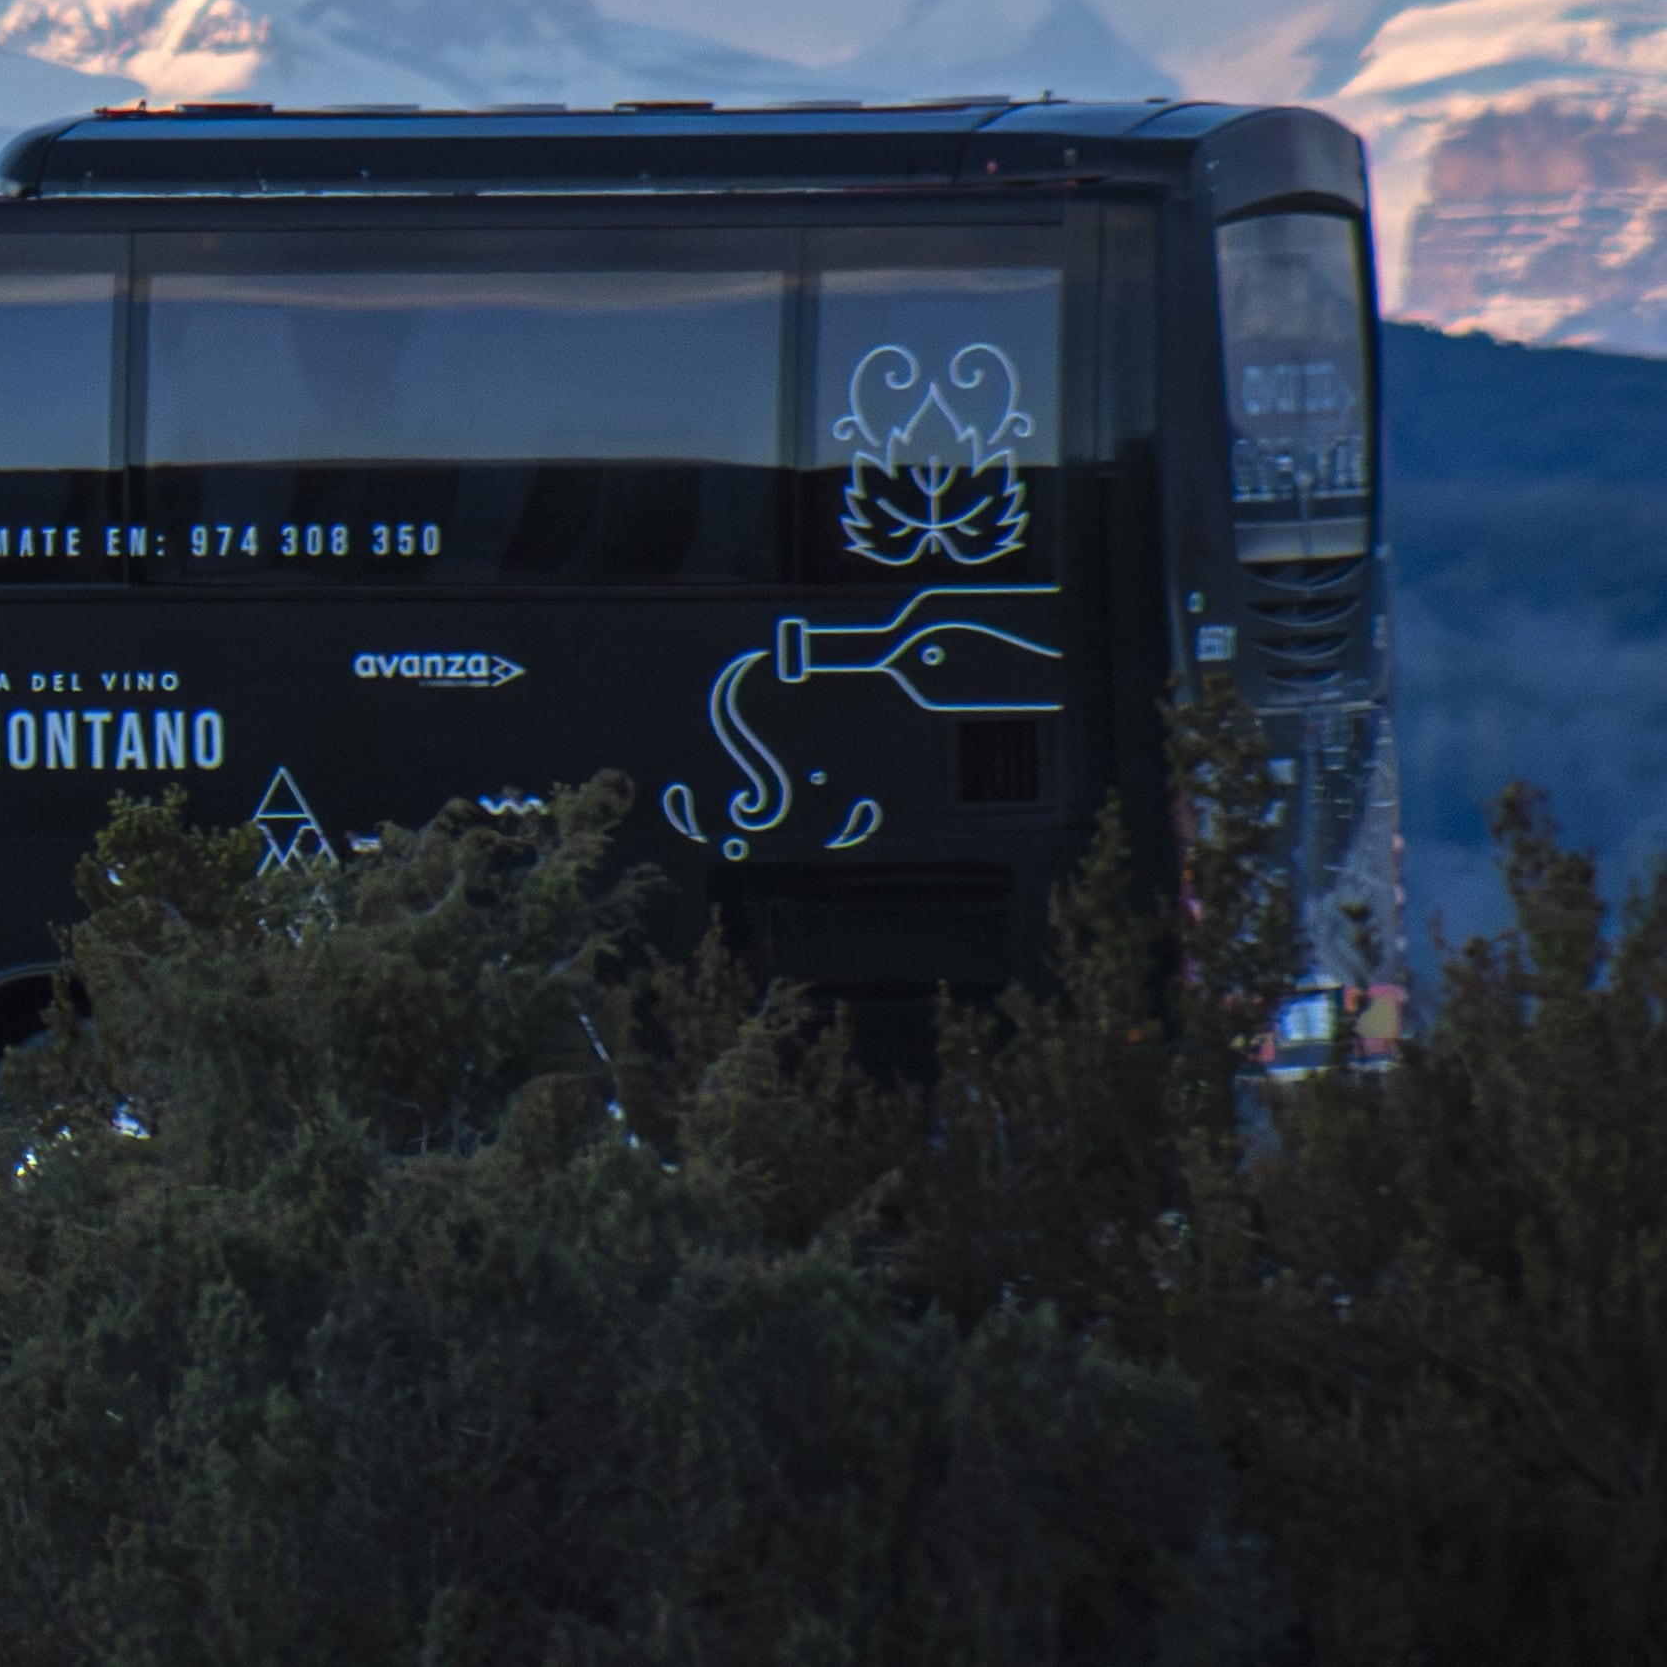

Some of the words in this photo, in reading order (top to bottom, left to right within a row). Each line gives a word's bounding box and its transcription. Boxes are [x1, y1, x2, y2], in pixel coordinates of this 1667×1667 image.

[106, 526, 165, 557] EN:
[190, 524, 259, 556] 974
[280, 524, 349, 556] 308
[371, 524, 440, 556] 350
[353, 651, 489, 678] avanza
[31, 672, 82, 692] DEL
[101, 671, 180, 692] VINO
